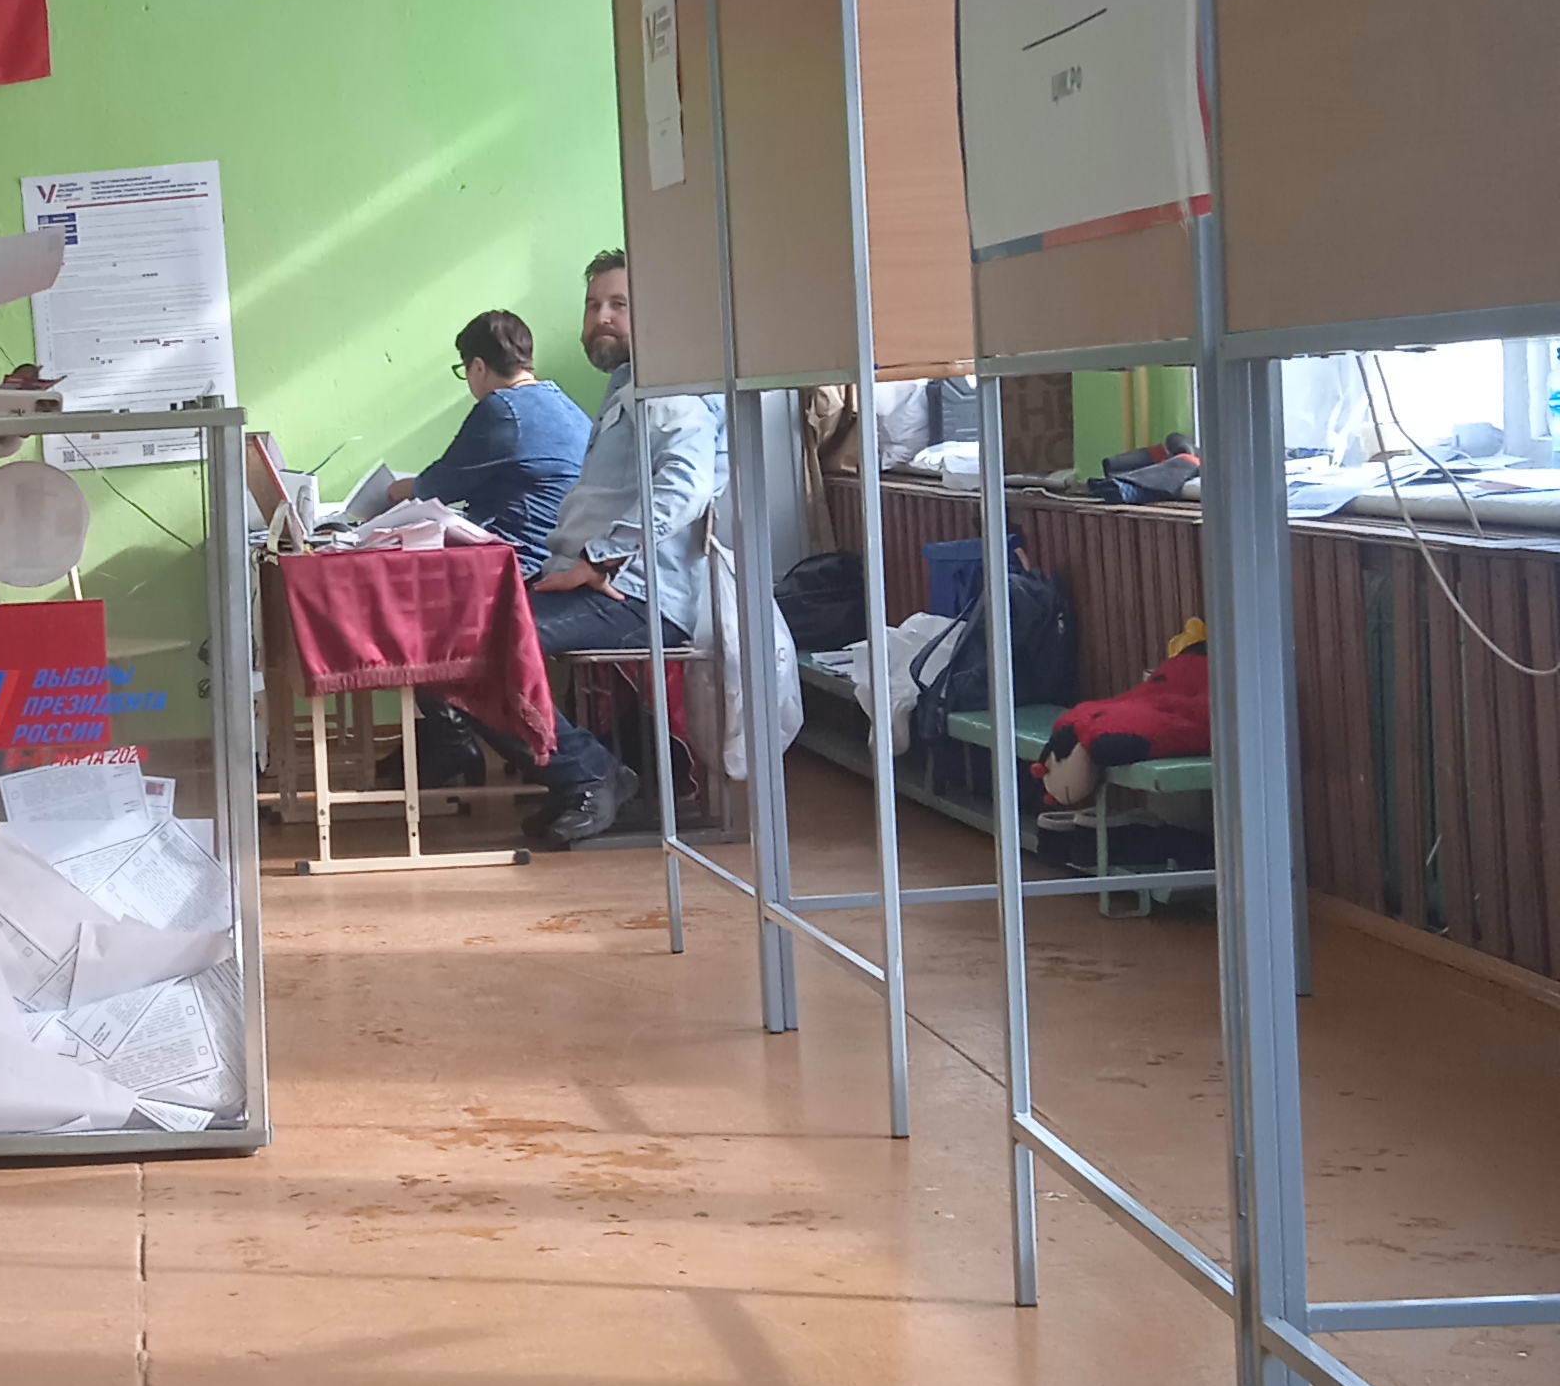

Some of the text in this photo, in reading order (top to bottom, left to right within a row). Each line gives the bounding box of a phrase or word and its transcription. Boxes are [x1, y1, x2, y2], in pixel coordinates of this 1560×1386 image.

[32, 666, 135, 689] ВЫБОРЫ
[22, 691, 167, 717] ПРЕЗИДЕНТА
[12, 722, 105, 745] РОССИИ
